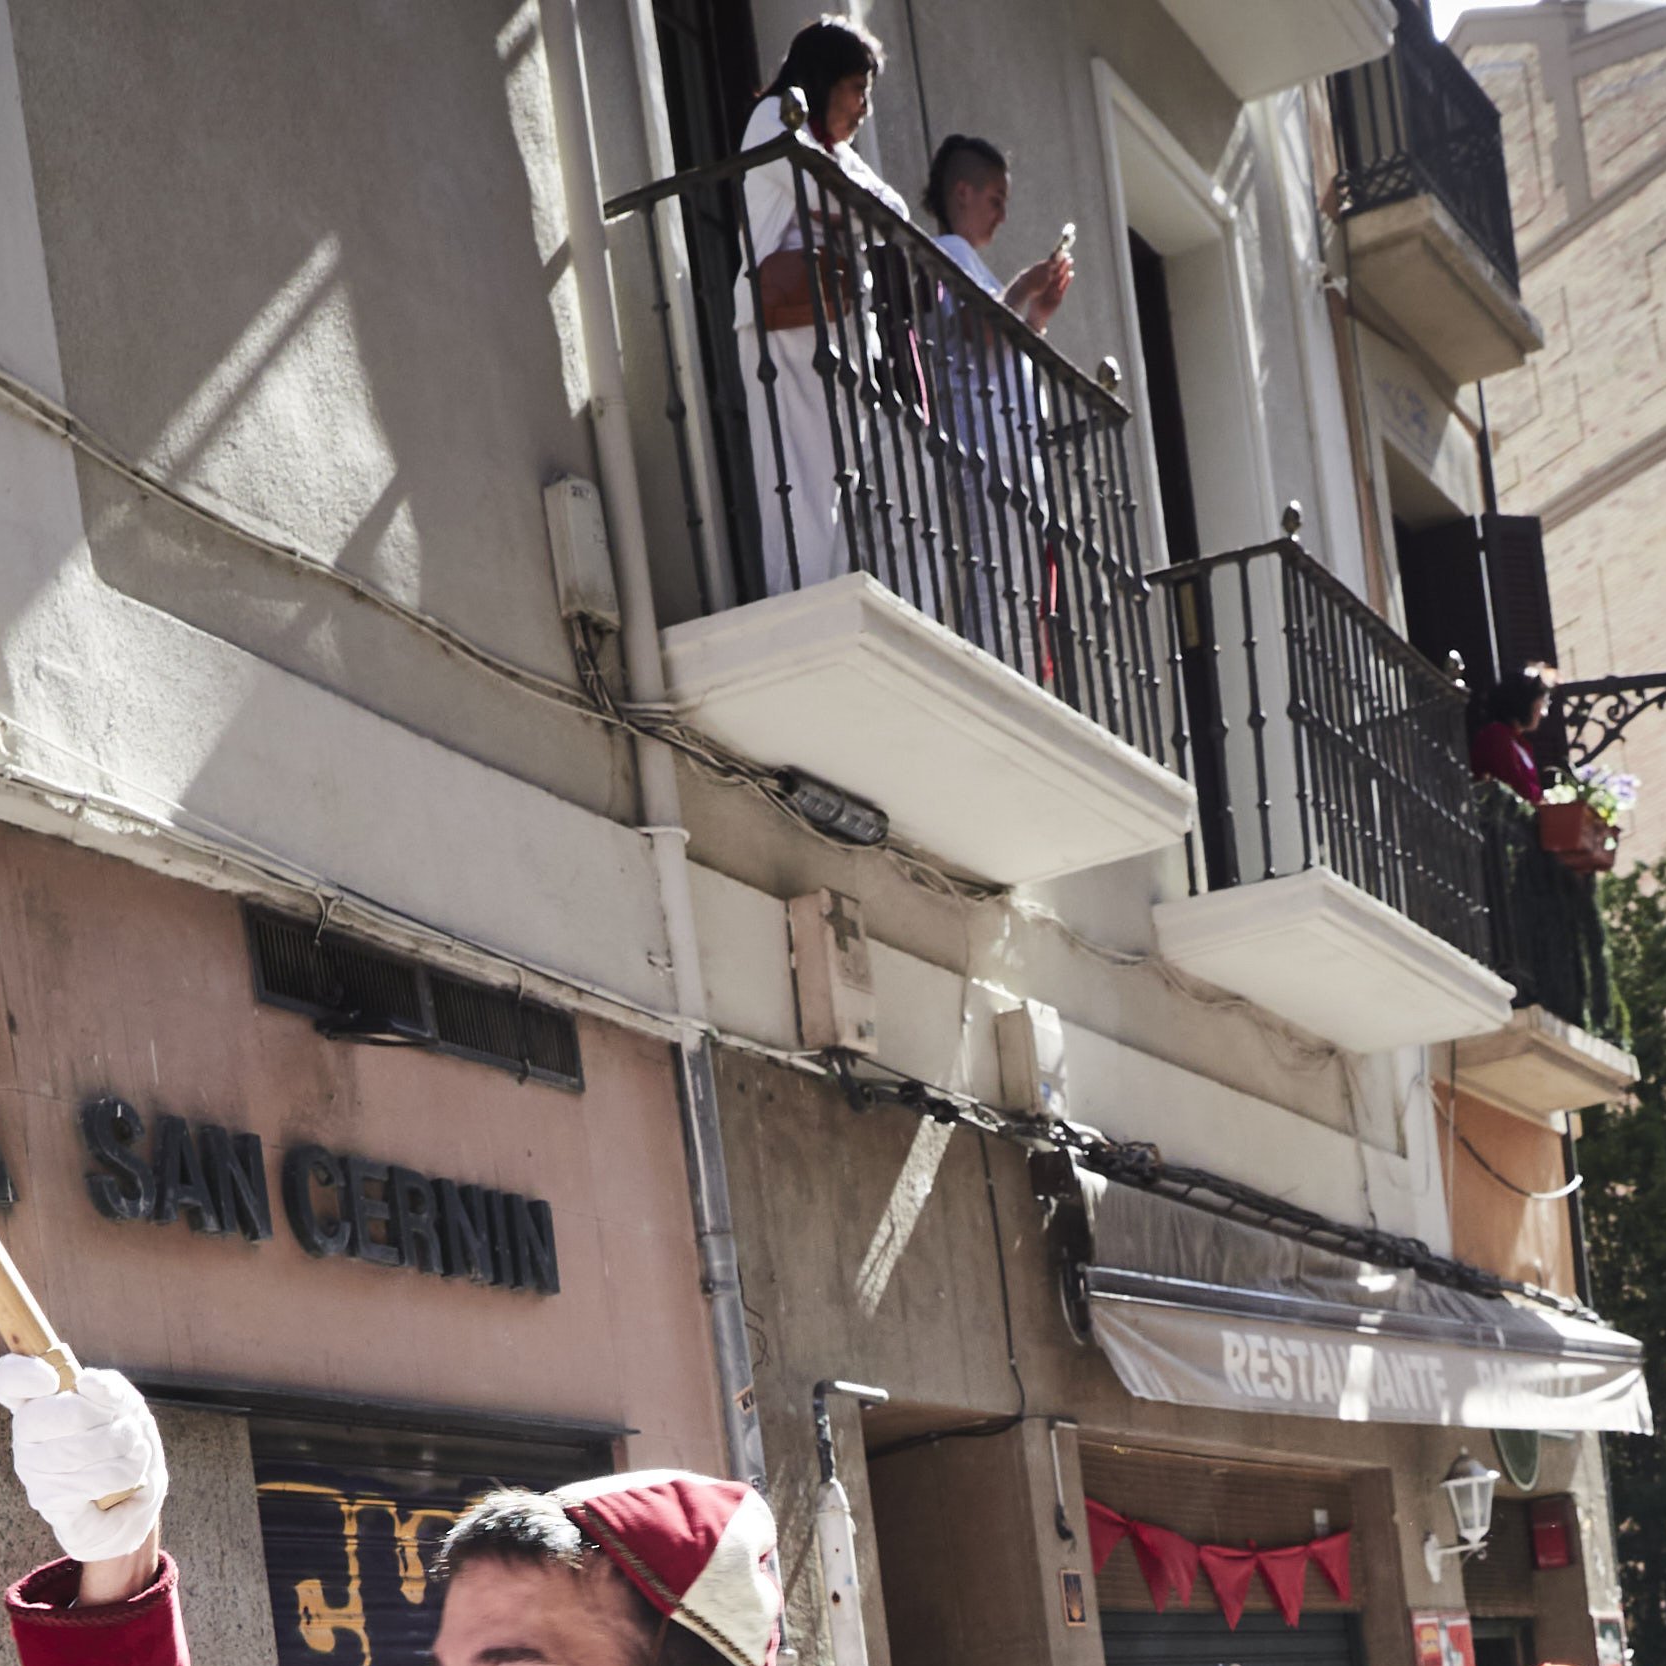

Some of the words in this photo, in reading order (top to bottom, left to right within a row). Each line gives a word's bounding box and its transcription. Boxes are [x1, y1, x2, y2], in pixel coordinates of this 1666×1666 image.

[81, 1097, 272, 1243] SAN
[281, 1143, 560, 1296] CERNIN
[1221, 1330, 1448, 1411] RESTAUANTE
